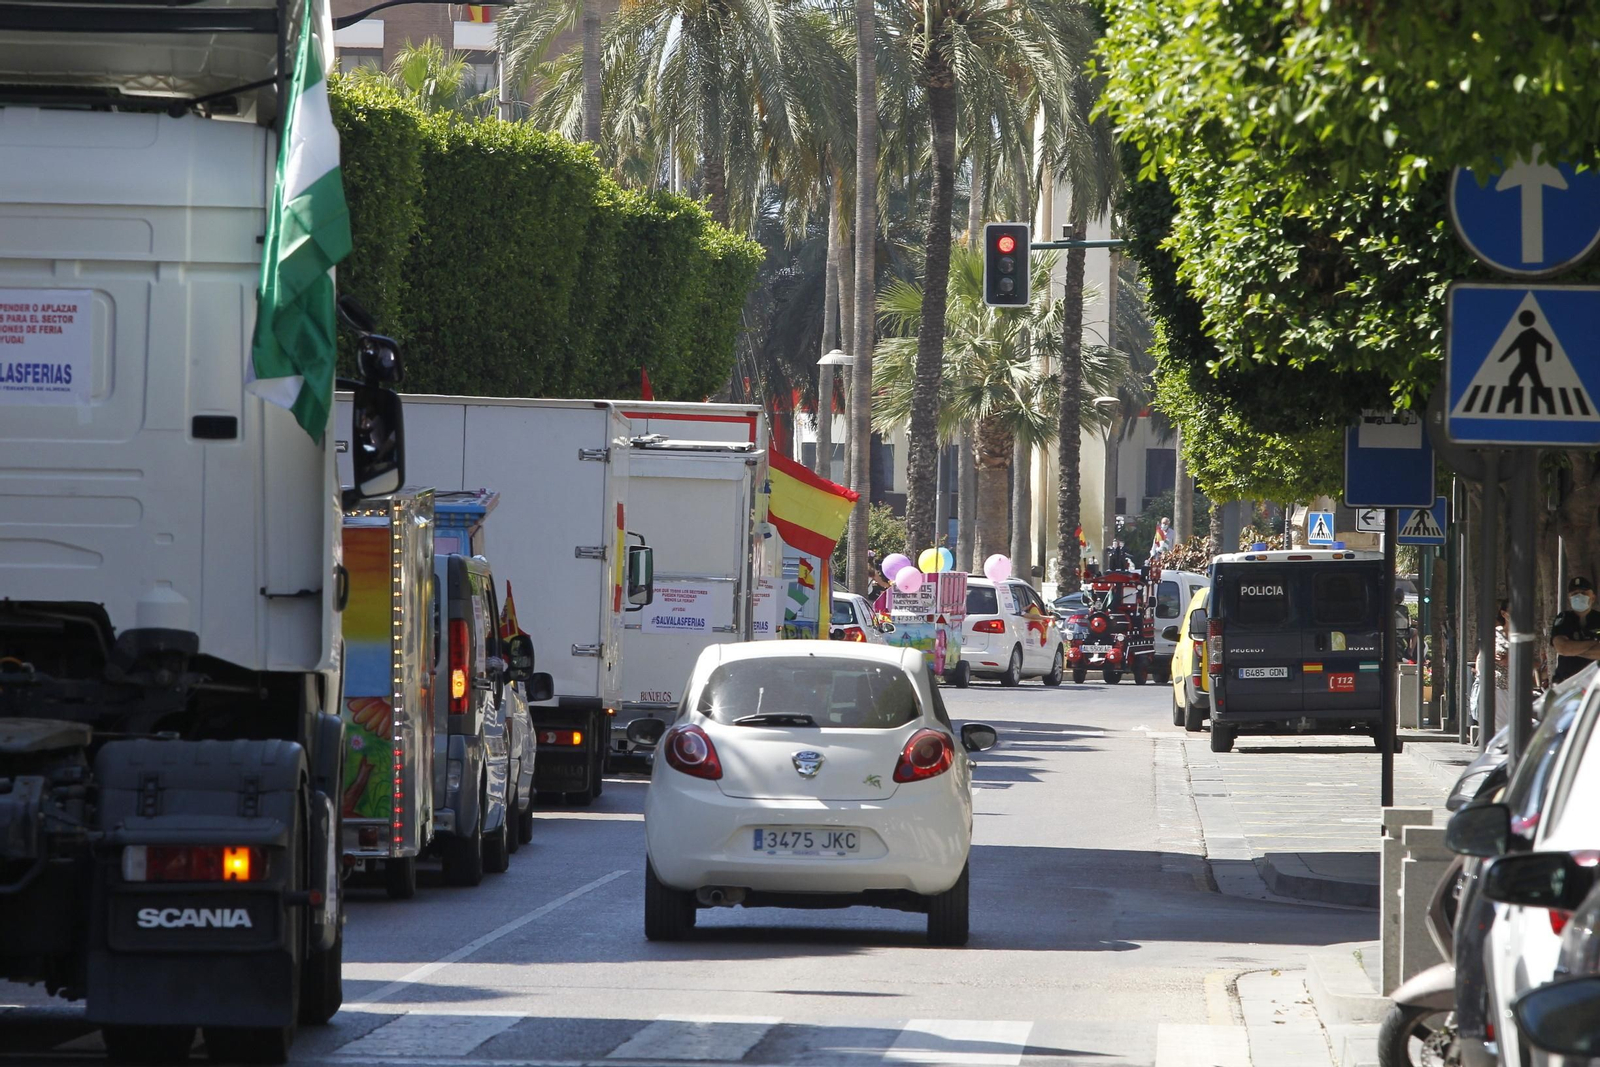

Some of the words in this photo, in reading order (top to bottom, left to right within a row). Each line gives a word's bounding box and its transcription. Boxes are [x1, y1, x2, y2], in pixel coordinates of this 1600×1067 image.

[32, 304, 38, 312] O
[41, 304, 77, 313] APLAZAR
[7, 315, 27, 323] PARA
[30, 315, 39, 323] EL
[42, 315, 73, 323] SECTOR
[26, 325, 36, 333] DE
[39, 326, 62, 334] FERIA
[1240, 585, 1284, 596] POLICIA
[1245, 668, 1265, 677] 6485
[1269, 668, 1285, 677] GDN
[1337, 676, 1353, 684] 112
[799, 751, 816, 759] Ford
[767, 832, 814, 849] 3475
[821, 832, 856, 849] JKC
[137, 908, 252, 928] SCANIA
